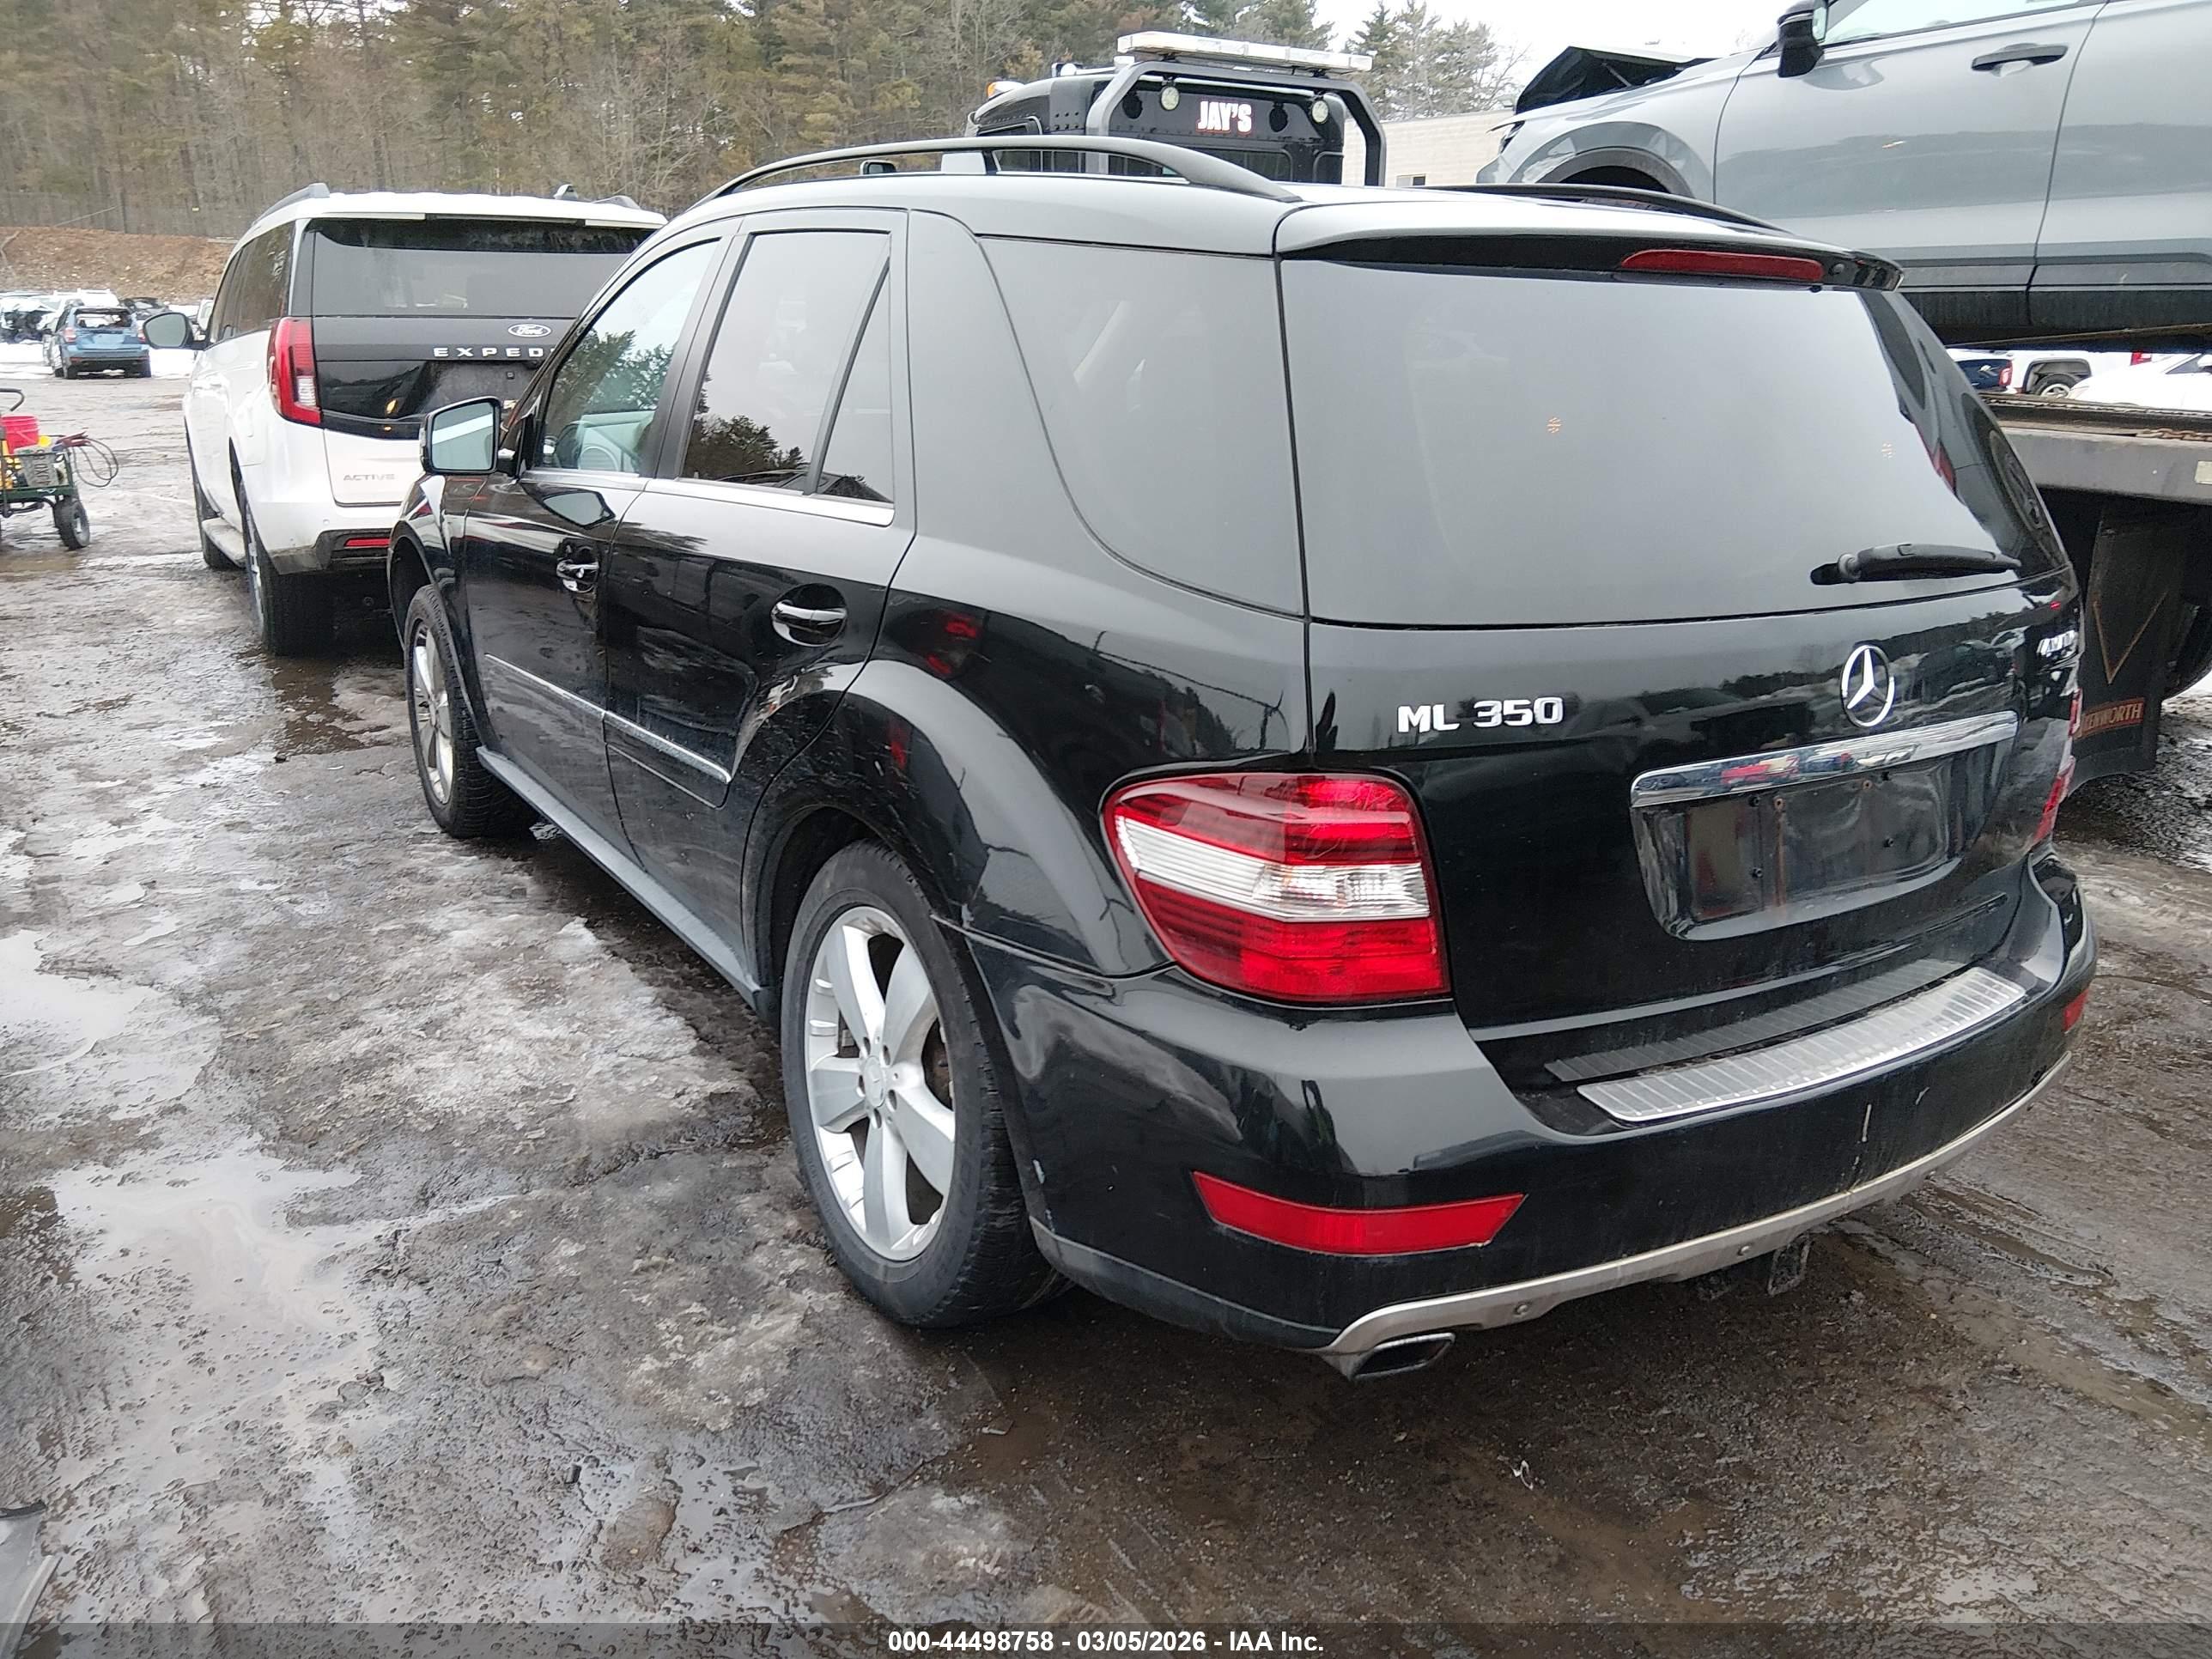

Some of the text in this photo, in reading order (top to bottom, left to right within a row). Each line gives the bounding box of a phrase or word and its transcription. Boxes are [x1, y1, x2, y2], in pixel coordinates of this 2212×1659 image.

[1197, 100, 1252, 133] JAY'S
[343, 473, 398, 482] ACTIVE
[1398, 696, 1564, 733] ML 350
